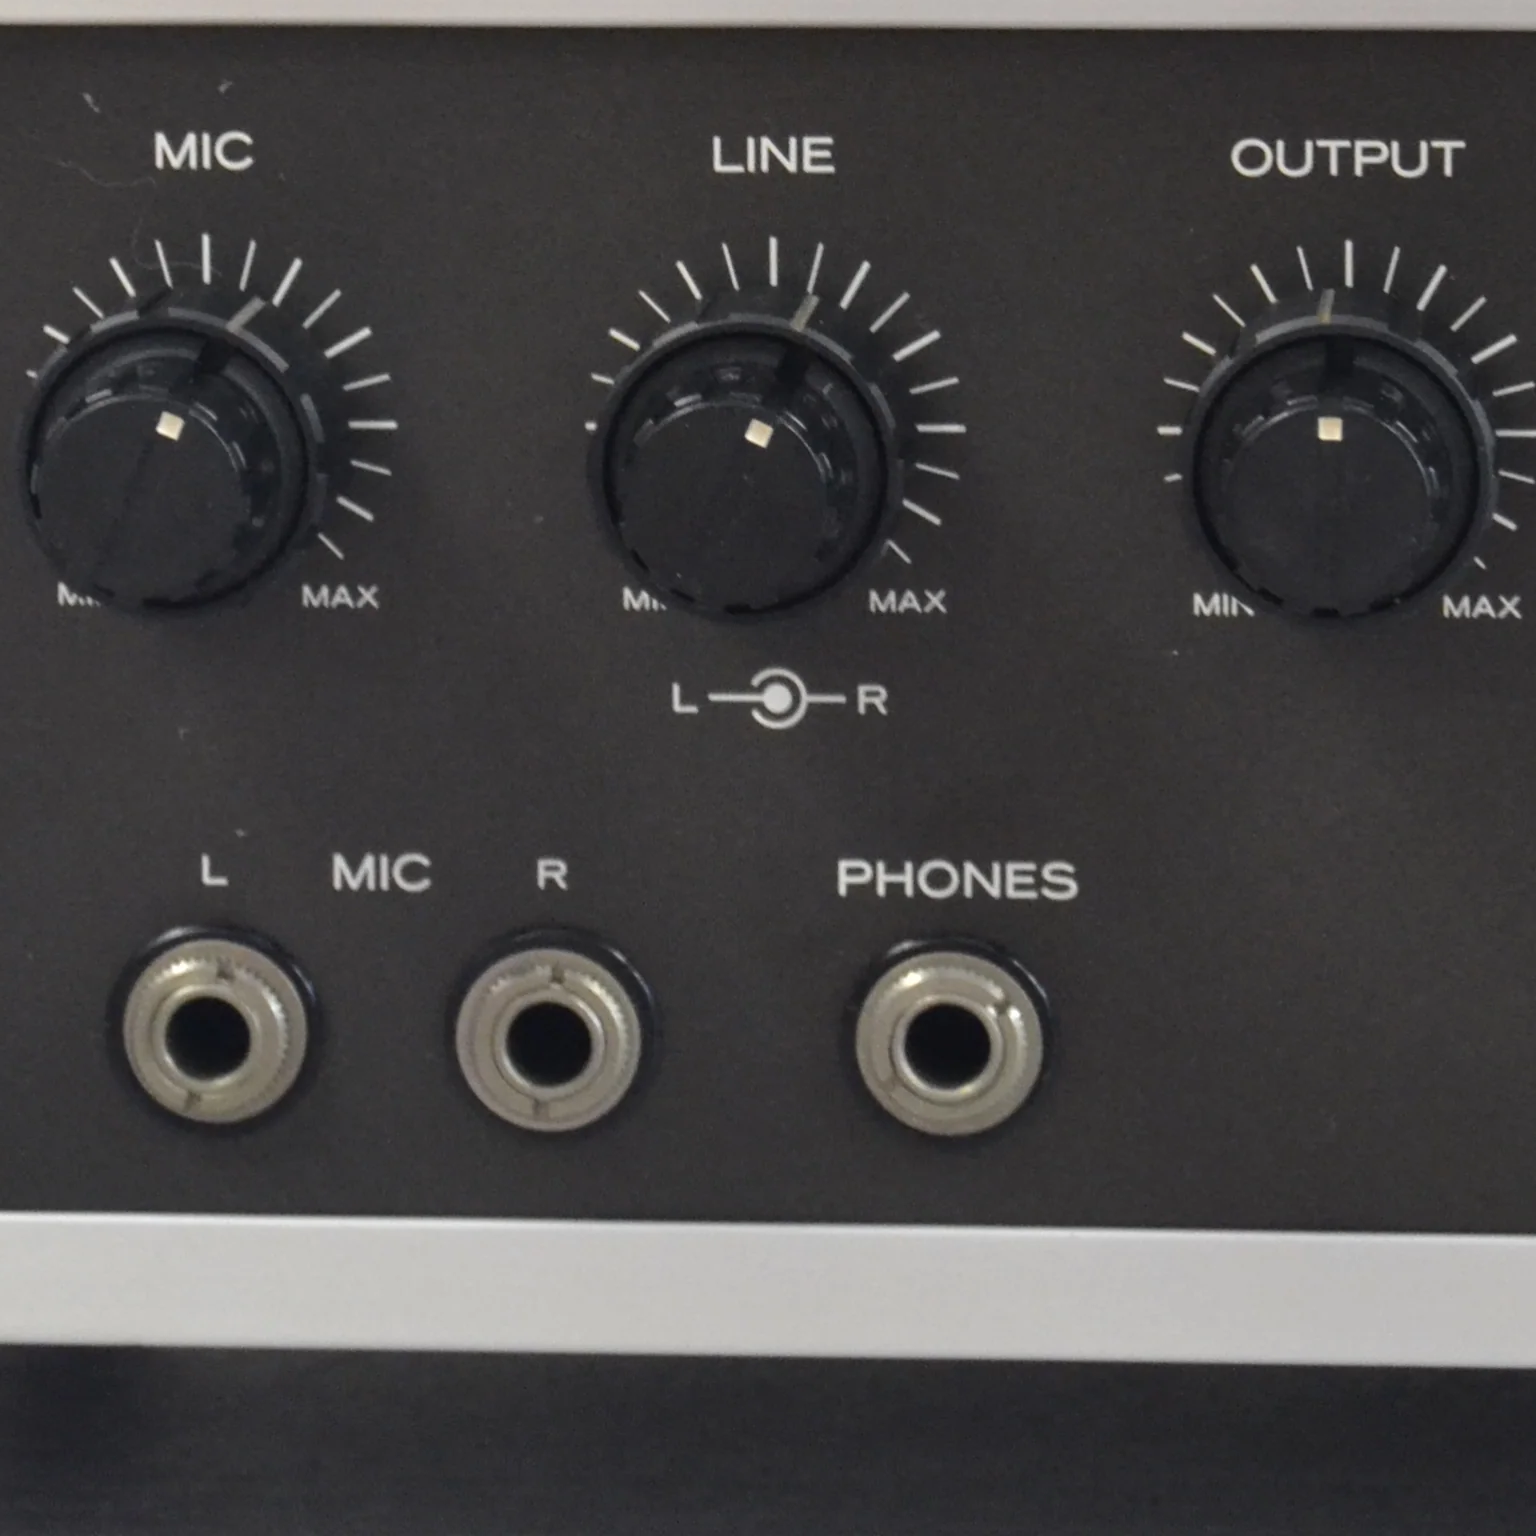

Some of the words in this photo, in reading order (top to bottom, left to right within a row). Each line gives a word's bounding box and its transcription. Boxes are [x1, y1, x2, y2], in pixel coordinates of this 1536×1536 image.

[154, 130, 254, 171] MIC
[712, 135, 836, 174] LINE
[1230, 137, 1467, 179] OUTPUT
[301, 584, 379, 609] MAX
[869, 589, 947, 614] MAX
[1442, 594, 1522, 619] MAX
[672, 682, 699, 714] L
[857, 684, 888, 715] R
[201, 854, 229, 886] L
[332, 852, 431, 892] MIC
[537, 858, 568, 890] R
[837, 858, 1079, 901] PHONES
